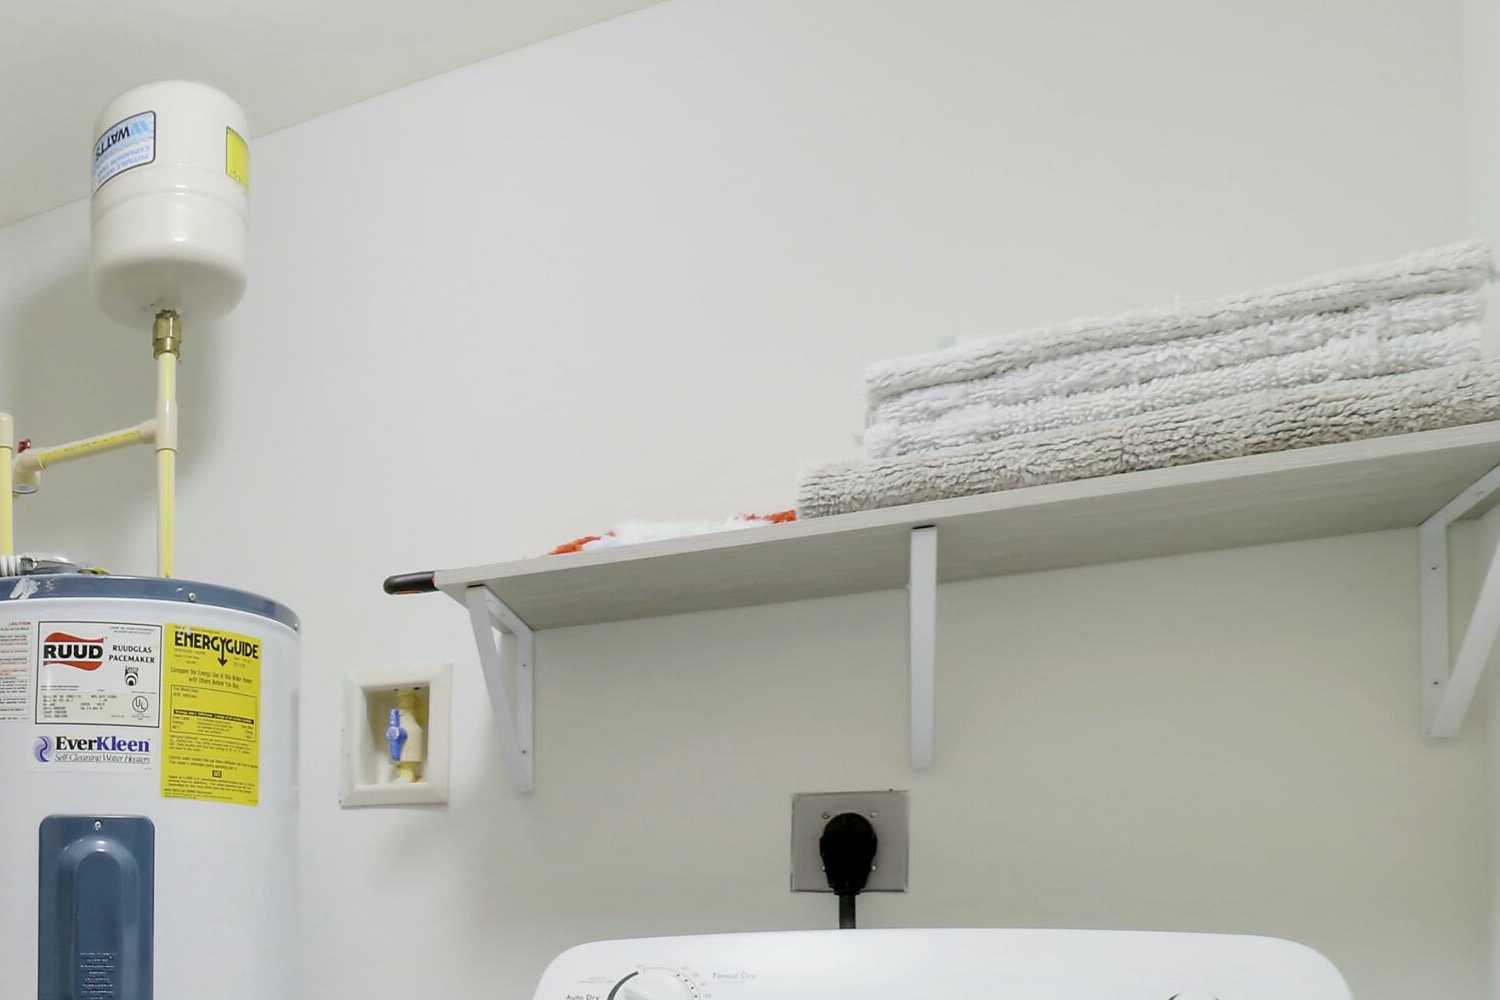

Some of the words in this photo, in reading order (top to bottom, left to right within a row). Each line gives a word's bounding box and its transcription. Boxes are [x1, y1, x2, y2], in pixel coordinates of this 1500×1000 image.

[112, 645, 153, 654] RUUDGLAS
[174, 631, 260, 660] ENERGYGUIDE
[43, 644, 104, 660] RUUD
[108, 655, 155, 664] PACEMAKER
[135, 698, 146, 710] UL
[56, 736, 151, 753] EverKleen
[54, 753, 102, 764] Self-Cleaning
[102, 754, 123, 763] Water
